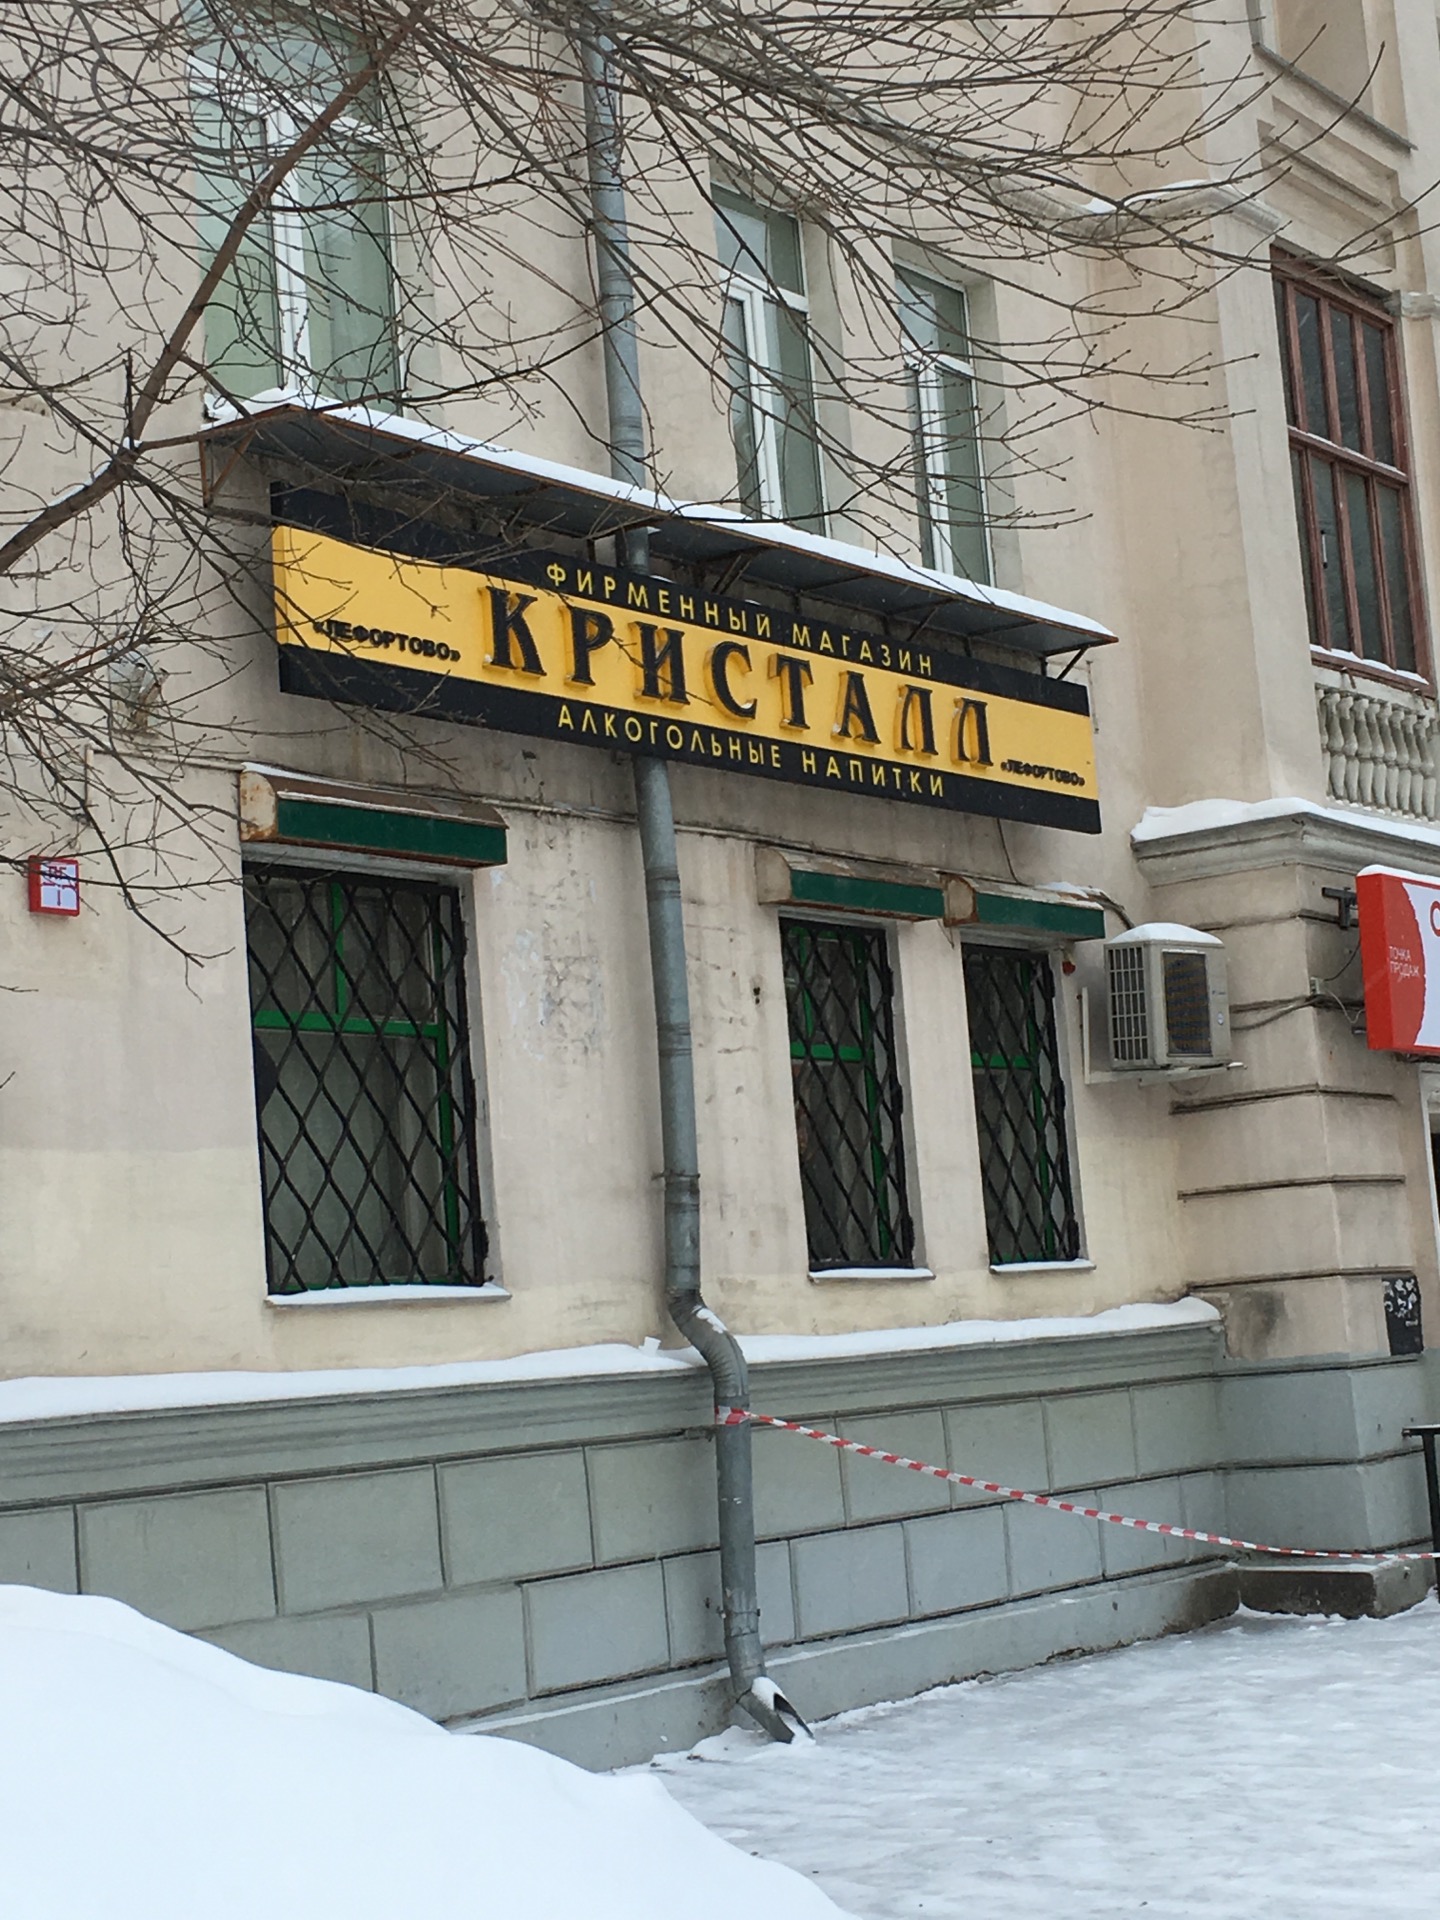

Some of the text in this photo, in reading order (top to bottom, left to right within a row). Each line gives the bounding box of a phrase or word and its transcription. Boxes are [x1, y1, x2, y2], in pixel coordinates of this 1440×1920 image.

[547, 562, 933, 677] ФИРМЕННЫЙ МАГАЗИН
[478, 585, 994, 768] КРИСТАЛЛ
[557, 704, 944, 798] АЛКОГОЛЬНЫЕ НАПИТКИ
[1388, 945, 1412, 961] ТОЧКА
[1389, 960, 1420, 978] ПРОДАЖ
